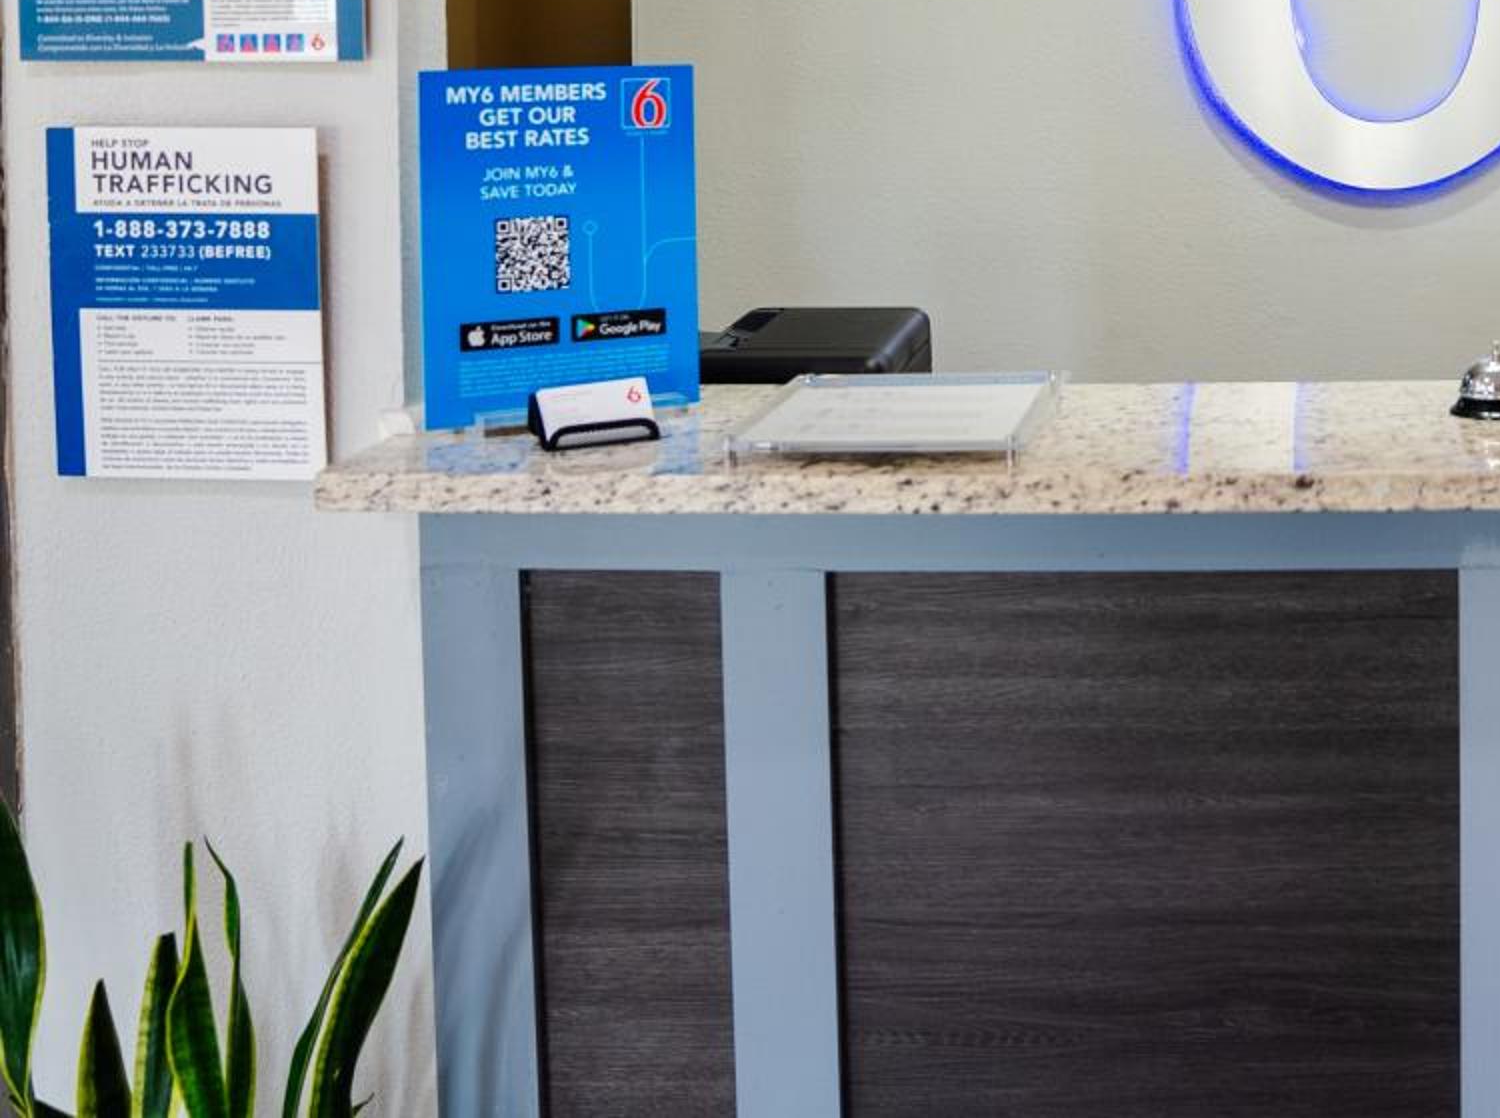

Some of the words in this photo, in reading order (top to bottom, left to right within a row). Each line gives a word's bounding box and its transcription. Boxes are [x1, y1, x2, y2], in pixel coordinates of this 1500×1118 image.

[446, 85, 495, 104] MY6
[501, 82, 607, 103] MEMBERS
[631, 77, 667, 129] 6
[479, 107, 523, 127] GET
[528, 106, 576, 124] OUR
[91, 139, 118, 147] HELP
[121, 139, 149, 147] STOP
[465, 130, 519, 150] BEST
[525, 127, 590, 147] RATES
[91, 151, 193, 170] HUMAN
[483, 166, 520, 182] JOIN
[525, 165, 558, 179] MY6
[562, 164, 574, 177] &
[93, 175, 273, 194] TRAFFICKING
[480, 185, 520, 200] SAVE
[525, 182, 577, 198] TODAY
[93, 220, 271, 239] 1-888-373-7888
[94, 244, 135, 258] TEXT
[141, 244, 195, 258] 233733
[199, 244, 272, 260] (BEFREE)
[599, 320, 638, 336] Google
[639, 319, 661, 333] Play
[491, 332, 518, 346] App
[519, 330, 553, 342] Store
[627, 386, 641, 402] 6
